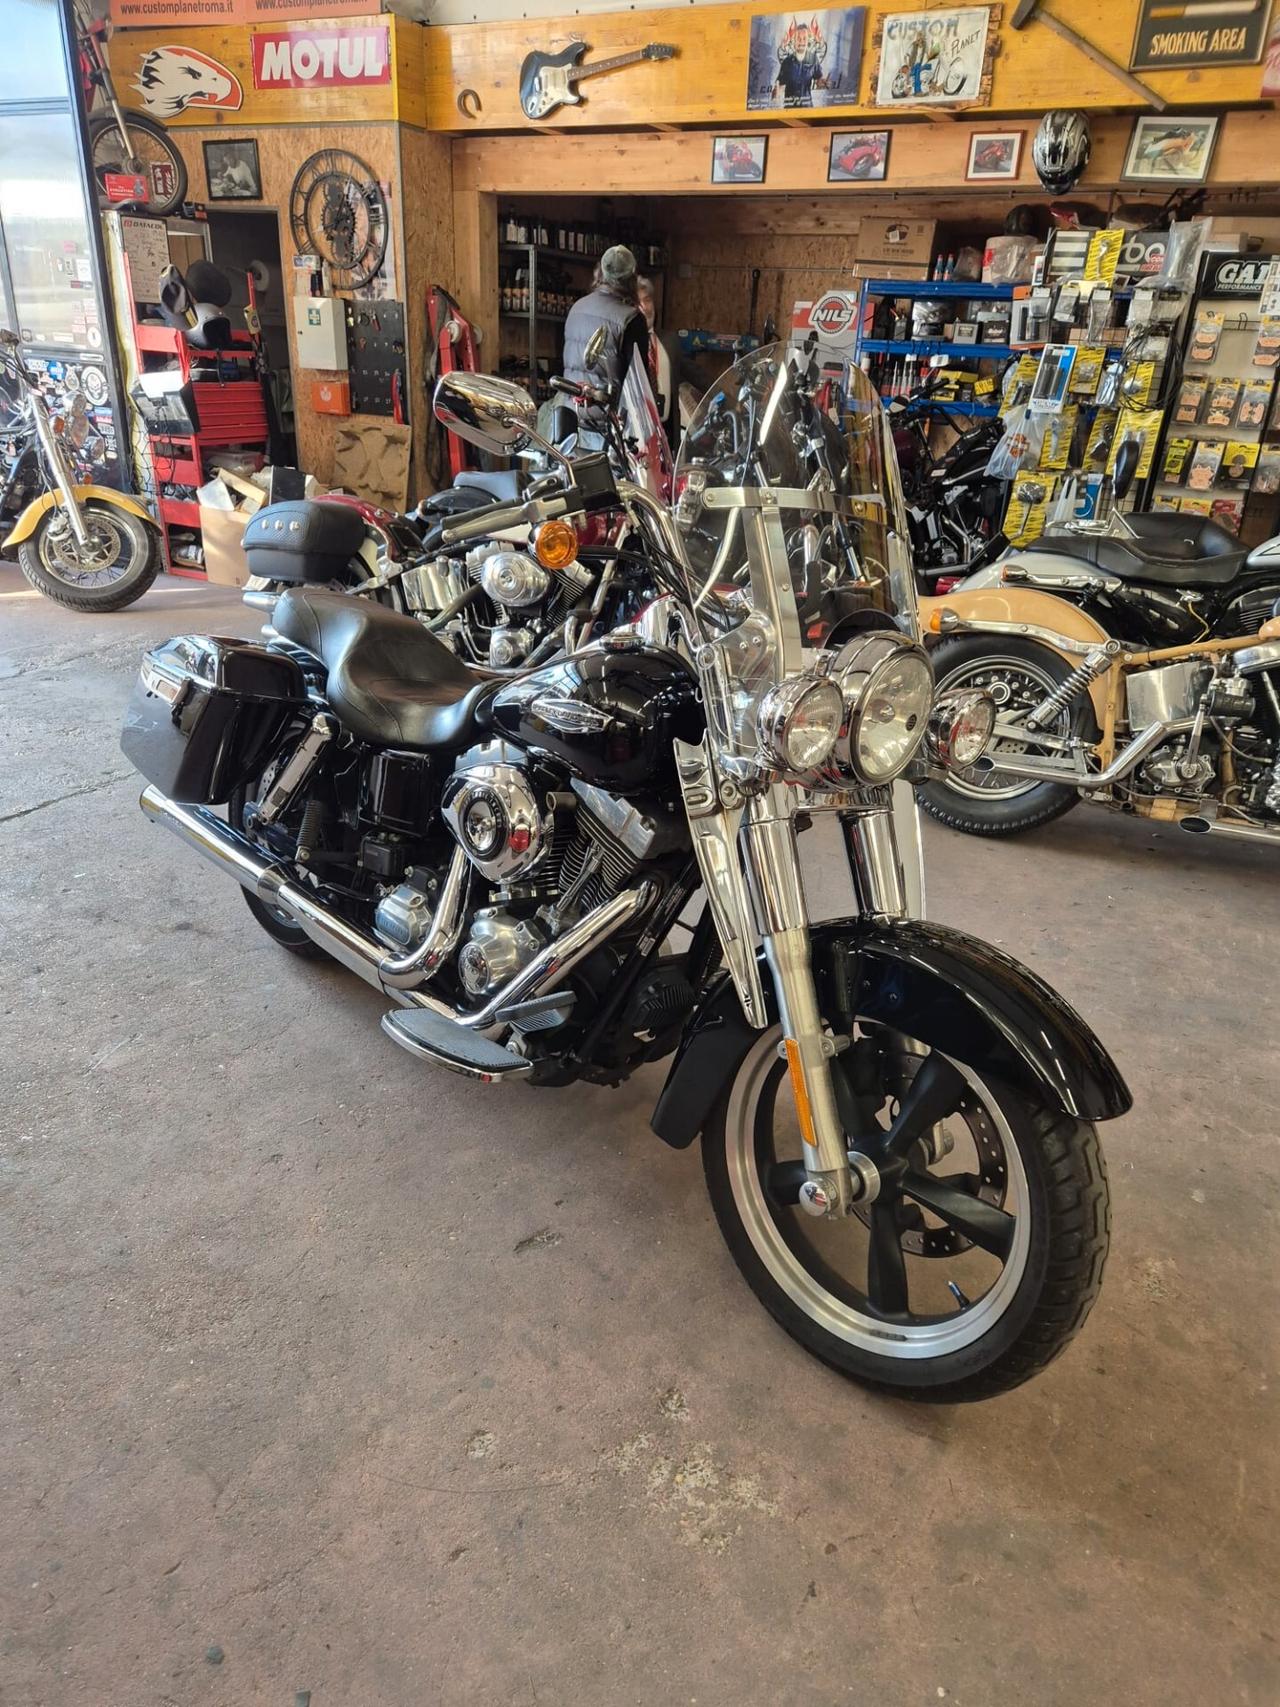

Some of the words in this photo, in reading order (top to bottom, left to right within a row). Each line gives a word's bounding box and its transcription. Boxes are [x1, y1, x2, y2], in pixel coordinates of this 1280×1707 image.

[120, 0, 234, 16] www.customplanetroma.it
[951, 29, 981, 57] PLANET
[1149, 30, 1209, 56] SMOKING
[1208, 27, 1247, 52] AREA
[261, 36, 384, 80] MOTUL
[813, 309, 852, 322] NILS
